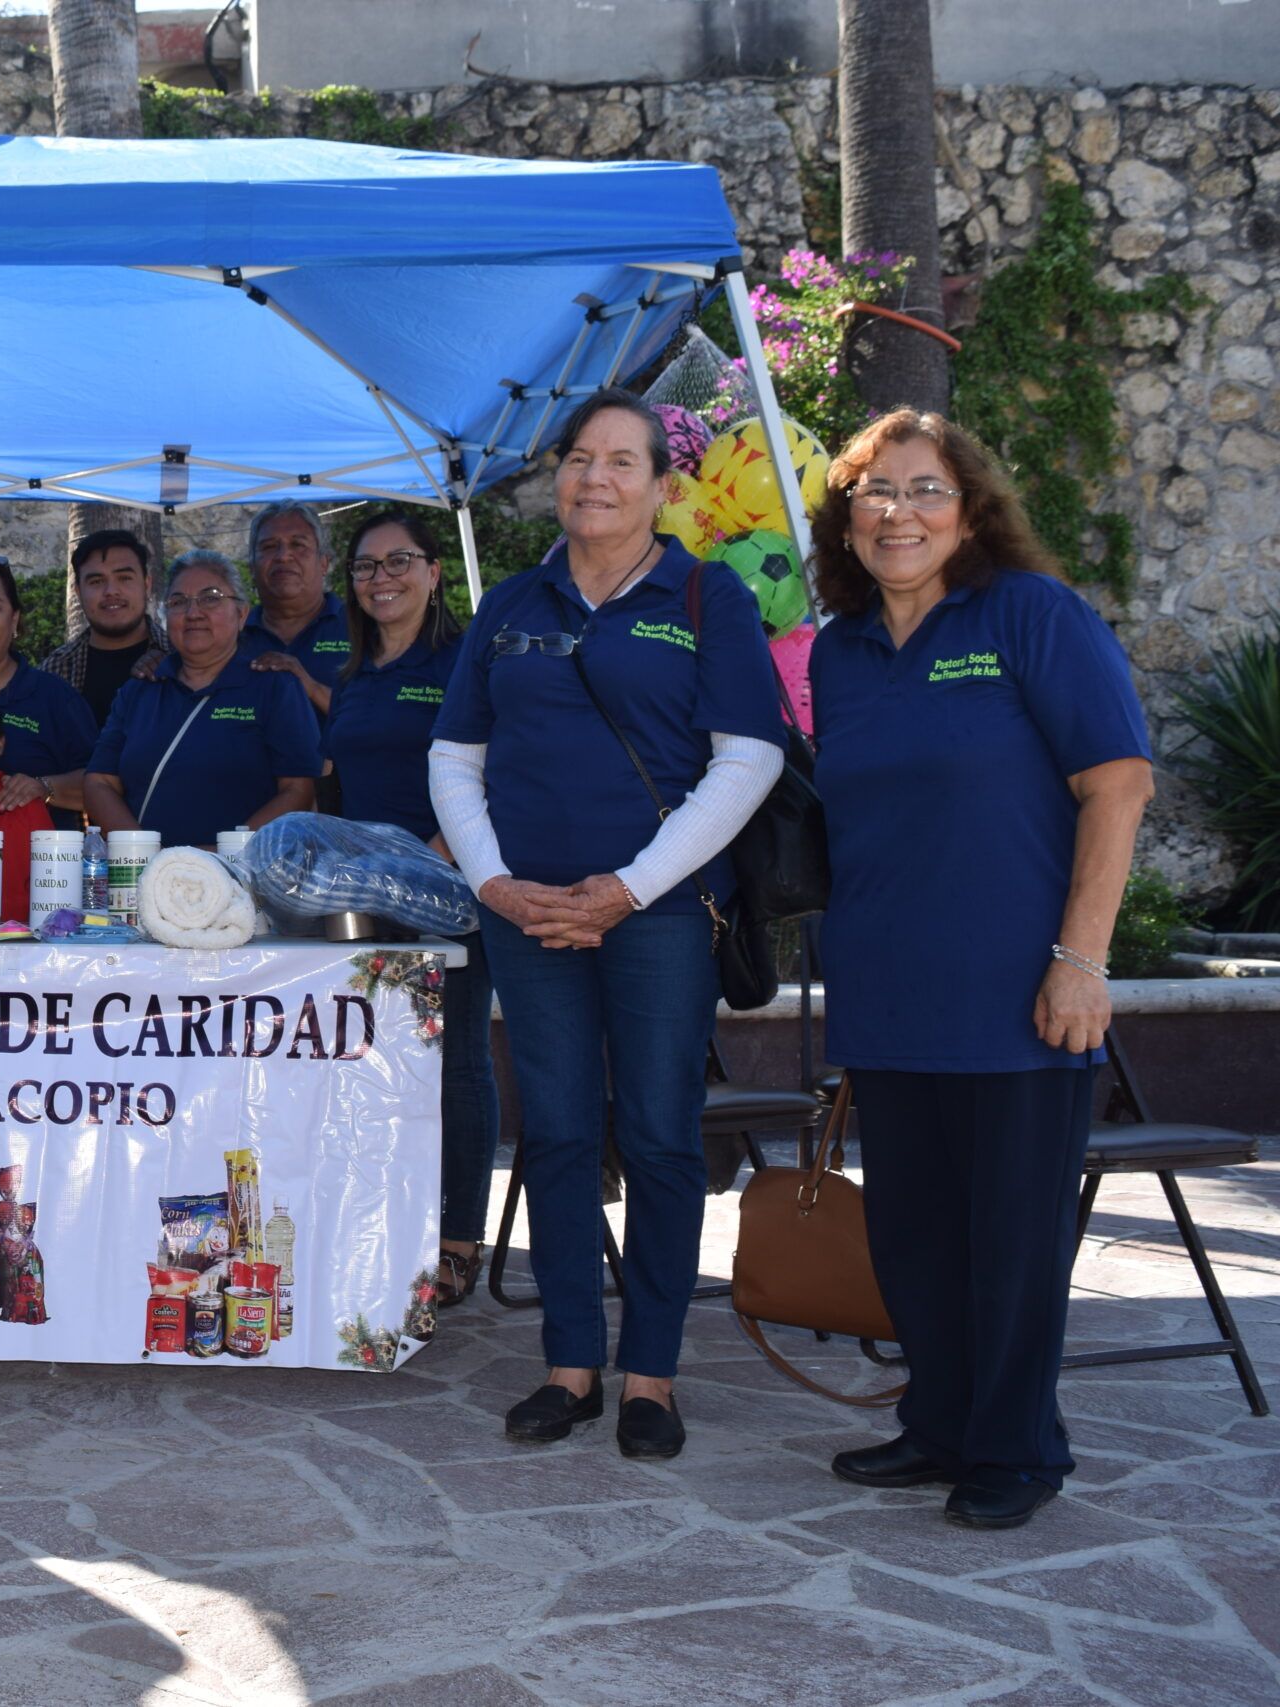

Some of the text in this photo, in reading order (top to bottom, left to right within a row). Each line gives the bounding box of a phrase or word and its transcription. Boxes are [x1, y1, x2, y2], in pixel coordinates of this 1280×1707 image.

[630, 628, 644, 637] San
[644, 631, 675, 643] Francisco
[675, 637, 684, 646] de
[636, 620, 695, 642] Pastoral Social
[934, 652, 998, 671] Pastoral Social
[928, 671, 942, 682] San
[942, 667, 972, 680] Francisco
[972, 665, 982, 676] de
[55, 852, 79, 862] ANUAL
[123, 856, 149, 865] Social
[34, 878, 68, 888] CARIDAD
[92, 991, 376, 1061] CARIDAD
[161, 1206, 190, 1220] Corn
